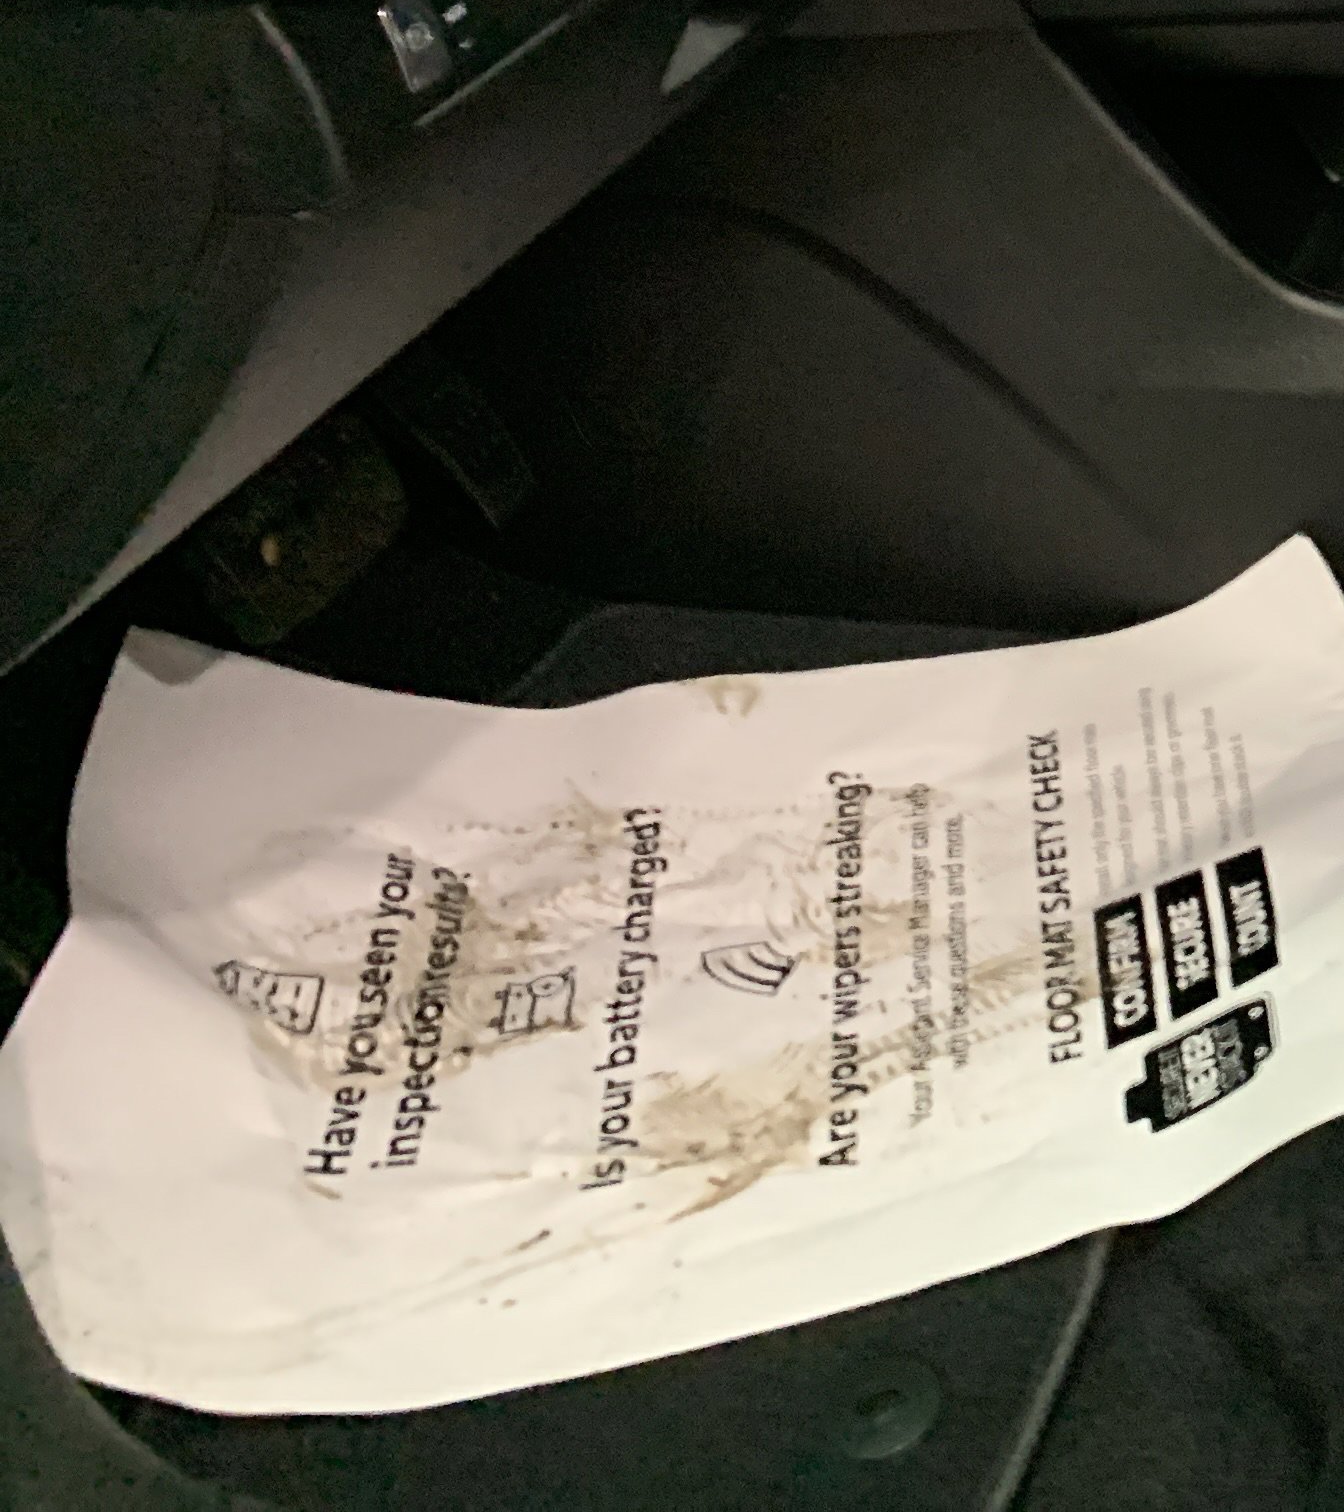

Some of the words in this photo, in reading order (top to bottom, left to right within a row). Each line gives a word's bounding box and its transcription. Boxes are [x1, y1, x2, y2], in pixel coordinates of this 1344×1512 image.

[1027, 729, 1065, 815] CHECK
[824, 770, 873, 917] streaking?
[909, 822, 931, 850] can
[1035, 822, 1074, 915] SAFETY
[374, 852, 416, 920] your
[612, 807, 668, 943] charged?
[908, 855, 934, 930] Manager
[941, 863, 965, 897] and
[359, 928, 400, 1007] seen
[820, 923, 870, 1026] wipers
[906, 934, 932, 994] Service
[943, 901, 968, 978] questions
[1042, 917, 1076, 971] MAT
[1104, 911, 1150, 1029] CONFIRM
[1167, 896, 1211, 989] SECURE
[339, 1012, 385, 1076] you
[593, 950, 658, 1072] battery
[1045, 971, 1084, 1064] FLOOR
[369, 984, 450, 1169] inspection
[830, 1032, 870, 1104] your
[908, 1080, 933, 1129] Your
[303, 1085, 366, 1175] Have
[597, 1079, 640, 1154] your
[818, 1107, 859, 1167] Are
[578, 1158, 626, 1190] Is
